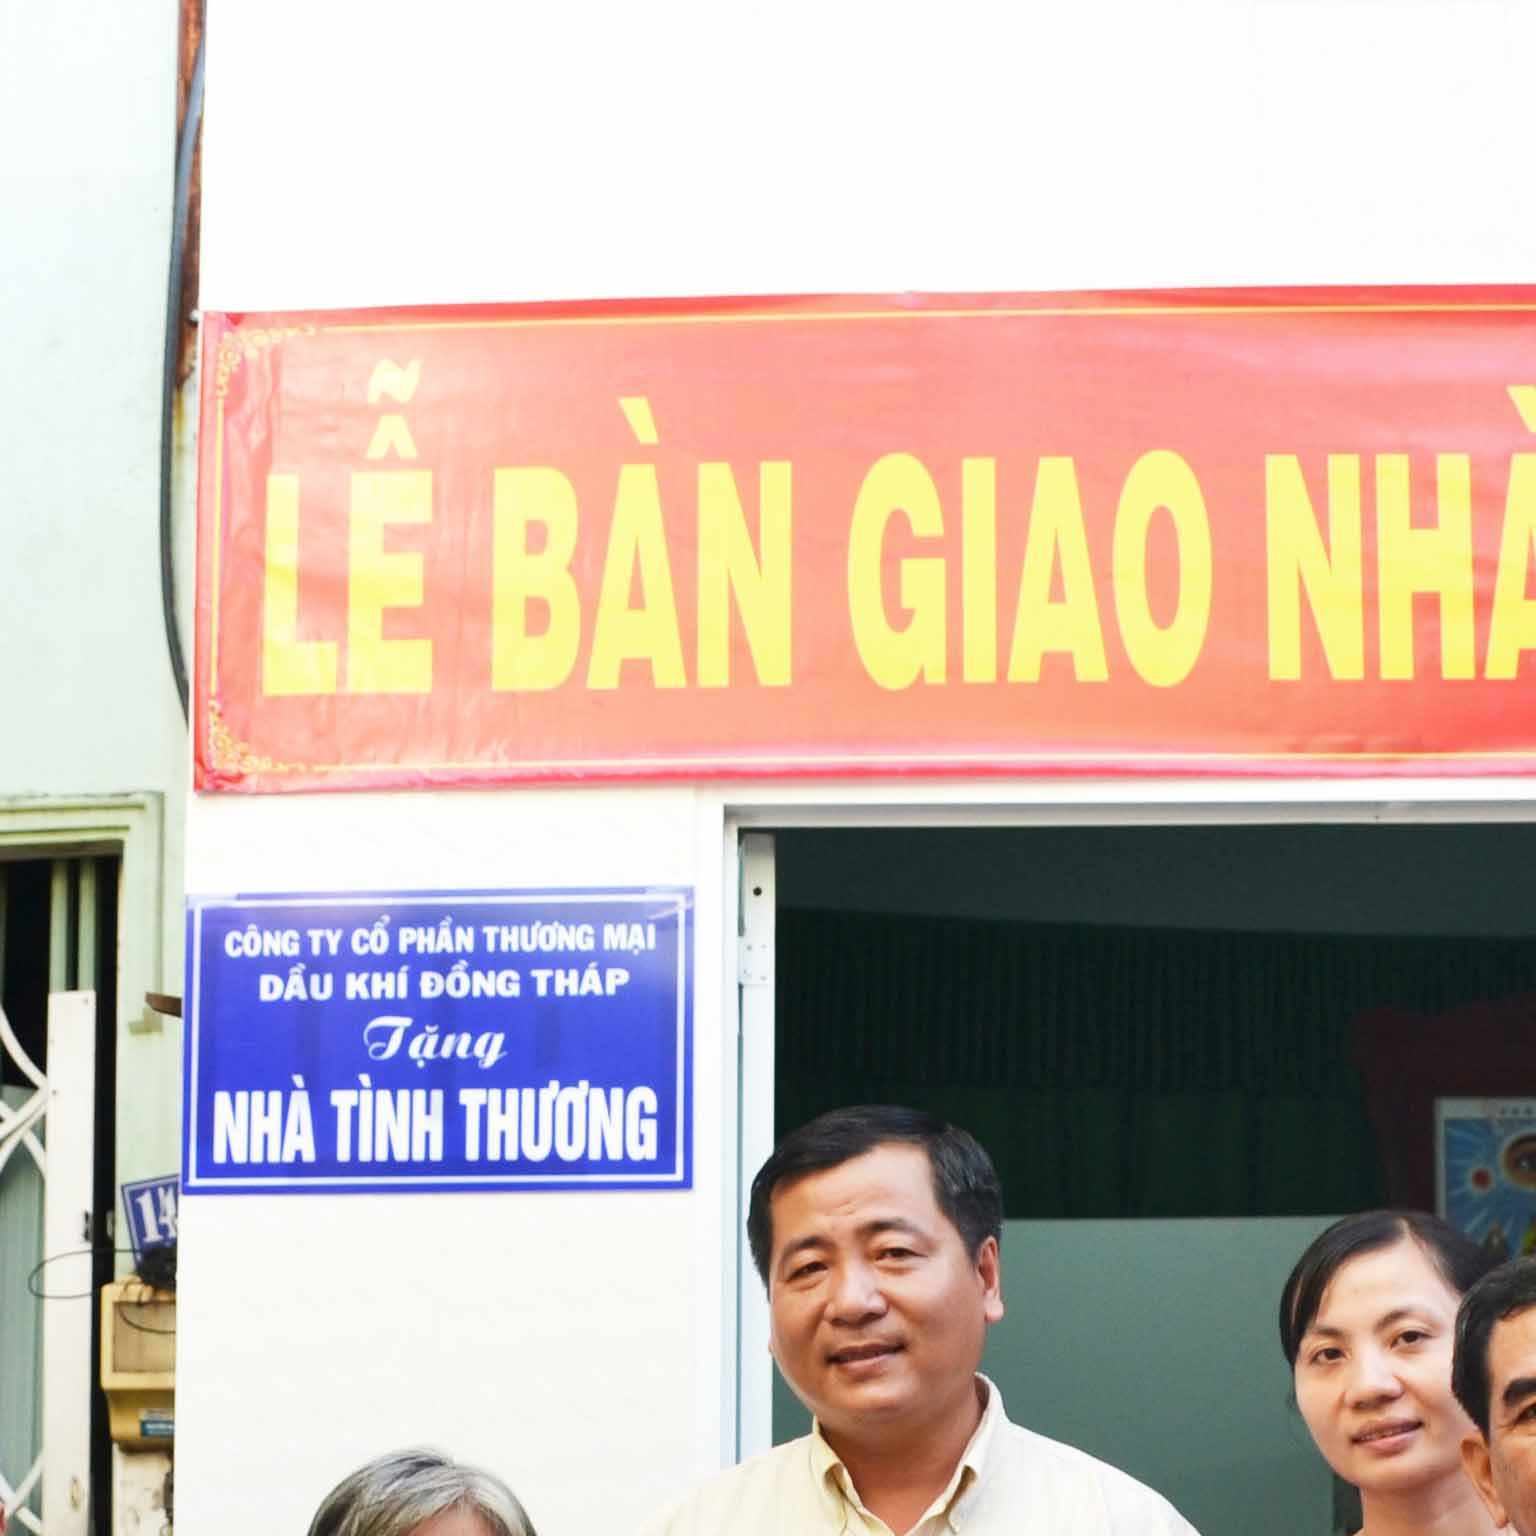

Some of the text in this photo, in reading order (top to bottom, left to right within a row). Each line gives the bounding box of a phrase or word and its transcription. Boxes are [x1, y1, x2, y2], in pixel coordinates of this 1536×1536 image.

[263, 358, 433, 696] LỄ
[490, 396, 794, 692] BÀN
[846, 449, 1214, 690] GIAO
[223, 914, 657, 958] CÔNG TY CỔ PHẦN THƯƠNG MẠI
[259, 959, 630, 1002] DẦU KHÍ ĐỒNG THÁP
[363, 1014, 510, 1069] Tặng
[212, 1073, 659, 1164] NHÀ TÌNH THƯƠNG
